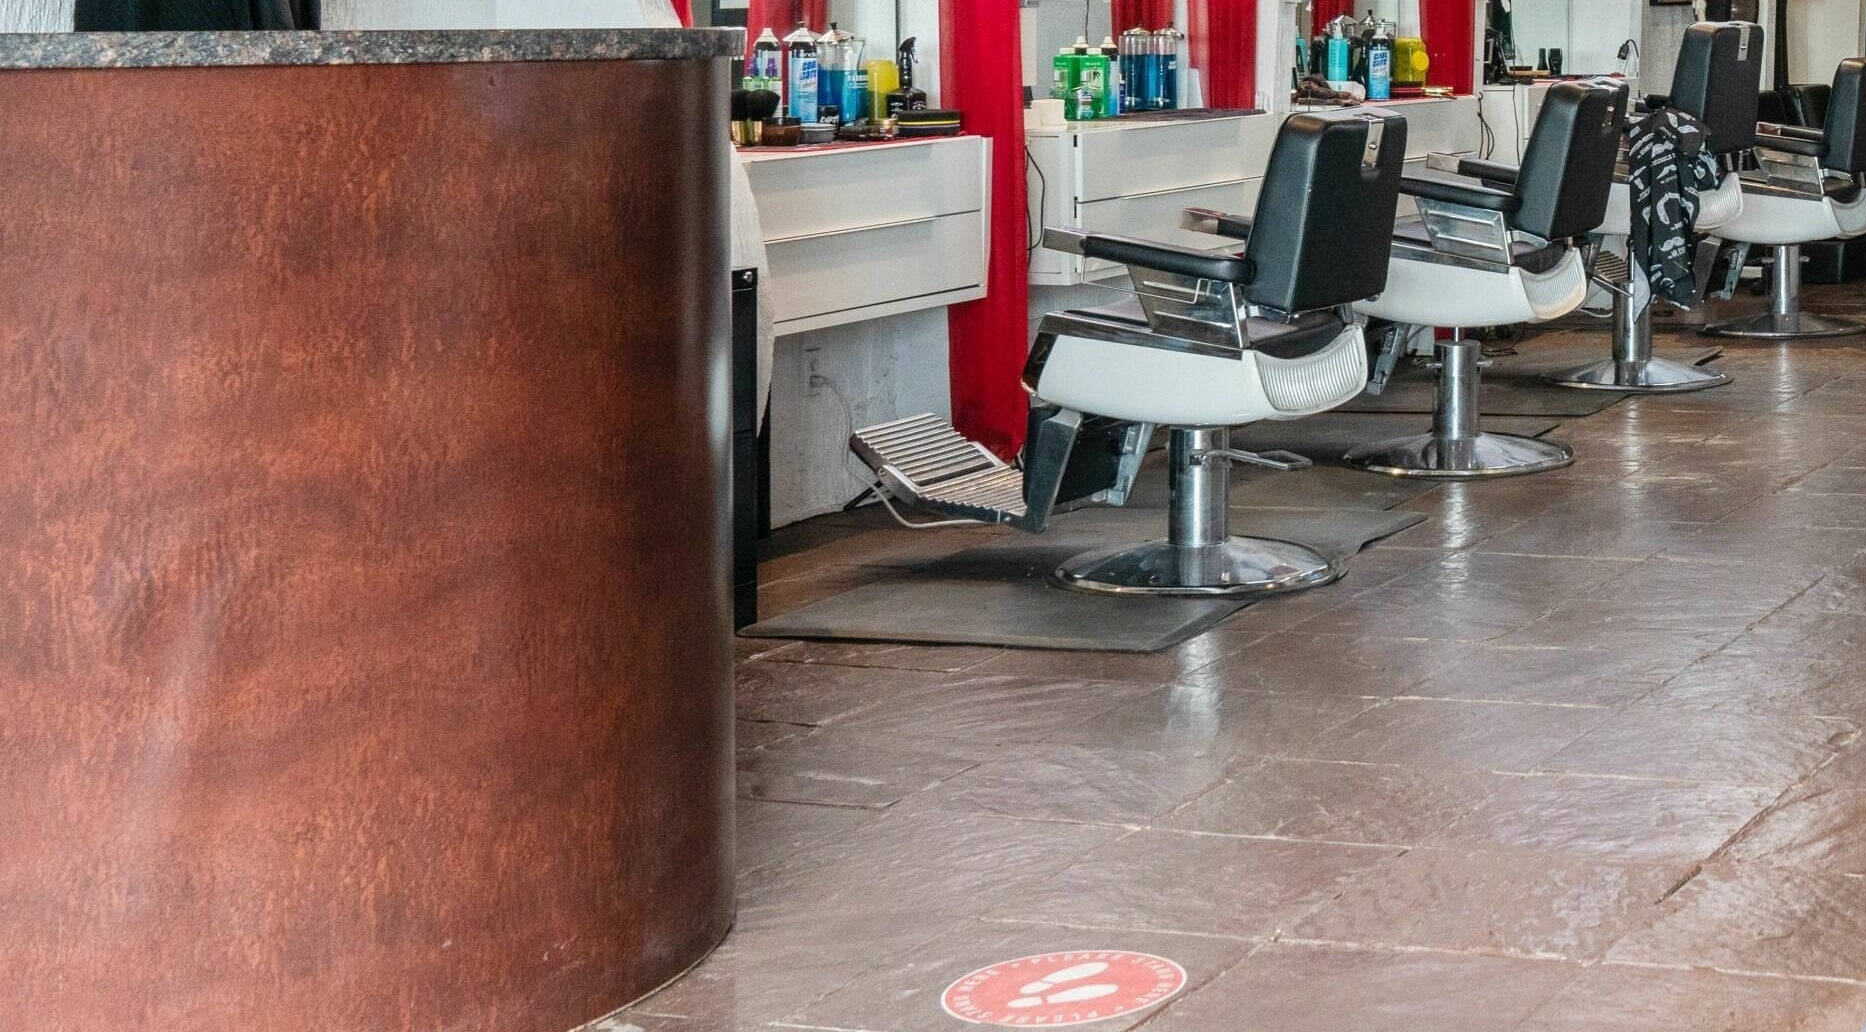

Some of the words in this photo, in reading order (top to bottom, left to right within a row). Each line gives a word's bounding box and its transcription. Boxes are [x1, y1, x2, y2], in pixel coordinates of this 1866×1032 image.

[1031, 953, 1124, 965] PLEASE
[1131, 957, 1175, 979] STAND
[957, 969, 1002, 992] HERE
[999, 1010, 1098, 1024] PLEASE
